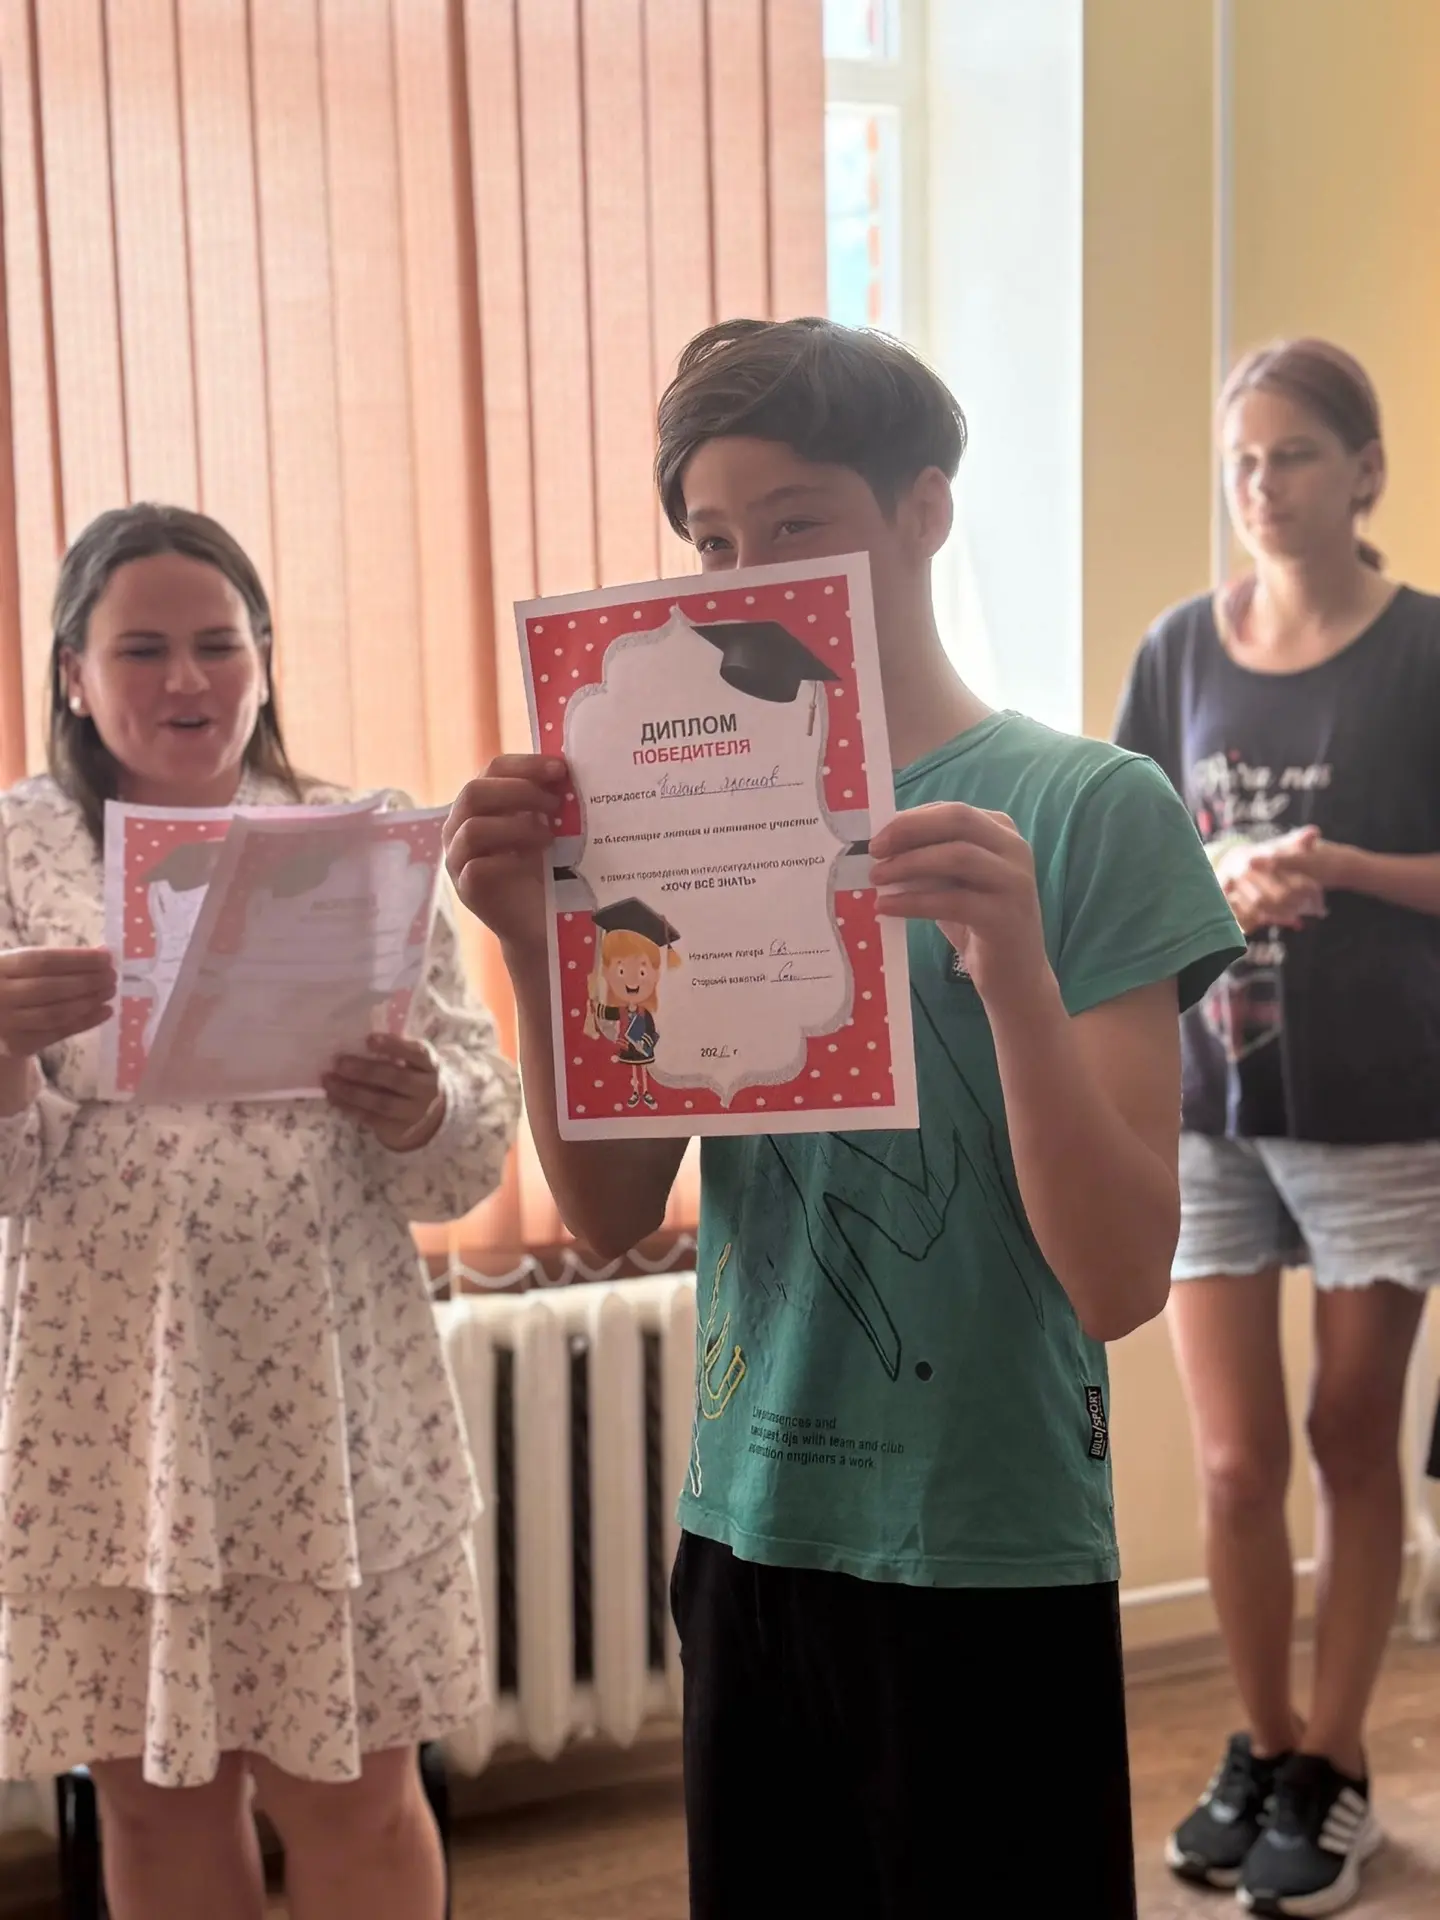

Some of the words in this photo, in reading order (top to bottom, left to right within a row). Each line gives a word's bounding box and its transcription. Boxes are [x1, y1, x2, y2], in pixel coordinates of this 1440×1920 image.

[641, 713, 737, 745] ДИПЛОМ
[633, 739, 751, 765] ПОБЕДИТЕЛЯ
[590, 790, 656, 805] награждается
[605, 831, 661, 844] блестящие
[703, 827, 710, 835] и
[712, 822, 767, 834] активное
[769, 817, 819, 831] участие
[607, 873, 636, 884] рамках
[637, 868, 690, 881] проведения
[780, 855, 825, 869] конкурса
[661, 881, 692, 892] «ХОЧУ
[695, 877, 715, 889] ВСЁ
[718, 875, 757, 888] ЗНАТЬ»
[814, 1416, 837, 1429] and
[802, 1432, 826, 1446] with
[829, 1436, 856, 1450] team
[858, 1438, 879, 1451] and
[880, 1441, 905, 1454] club
[849, 1457, 875, 1469] work
